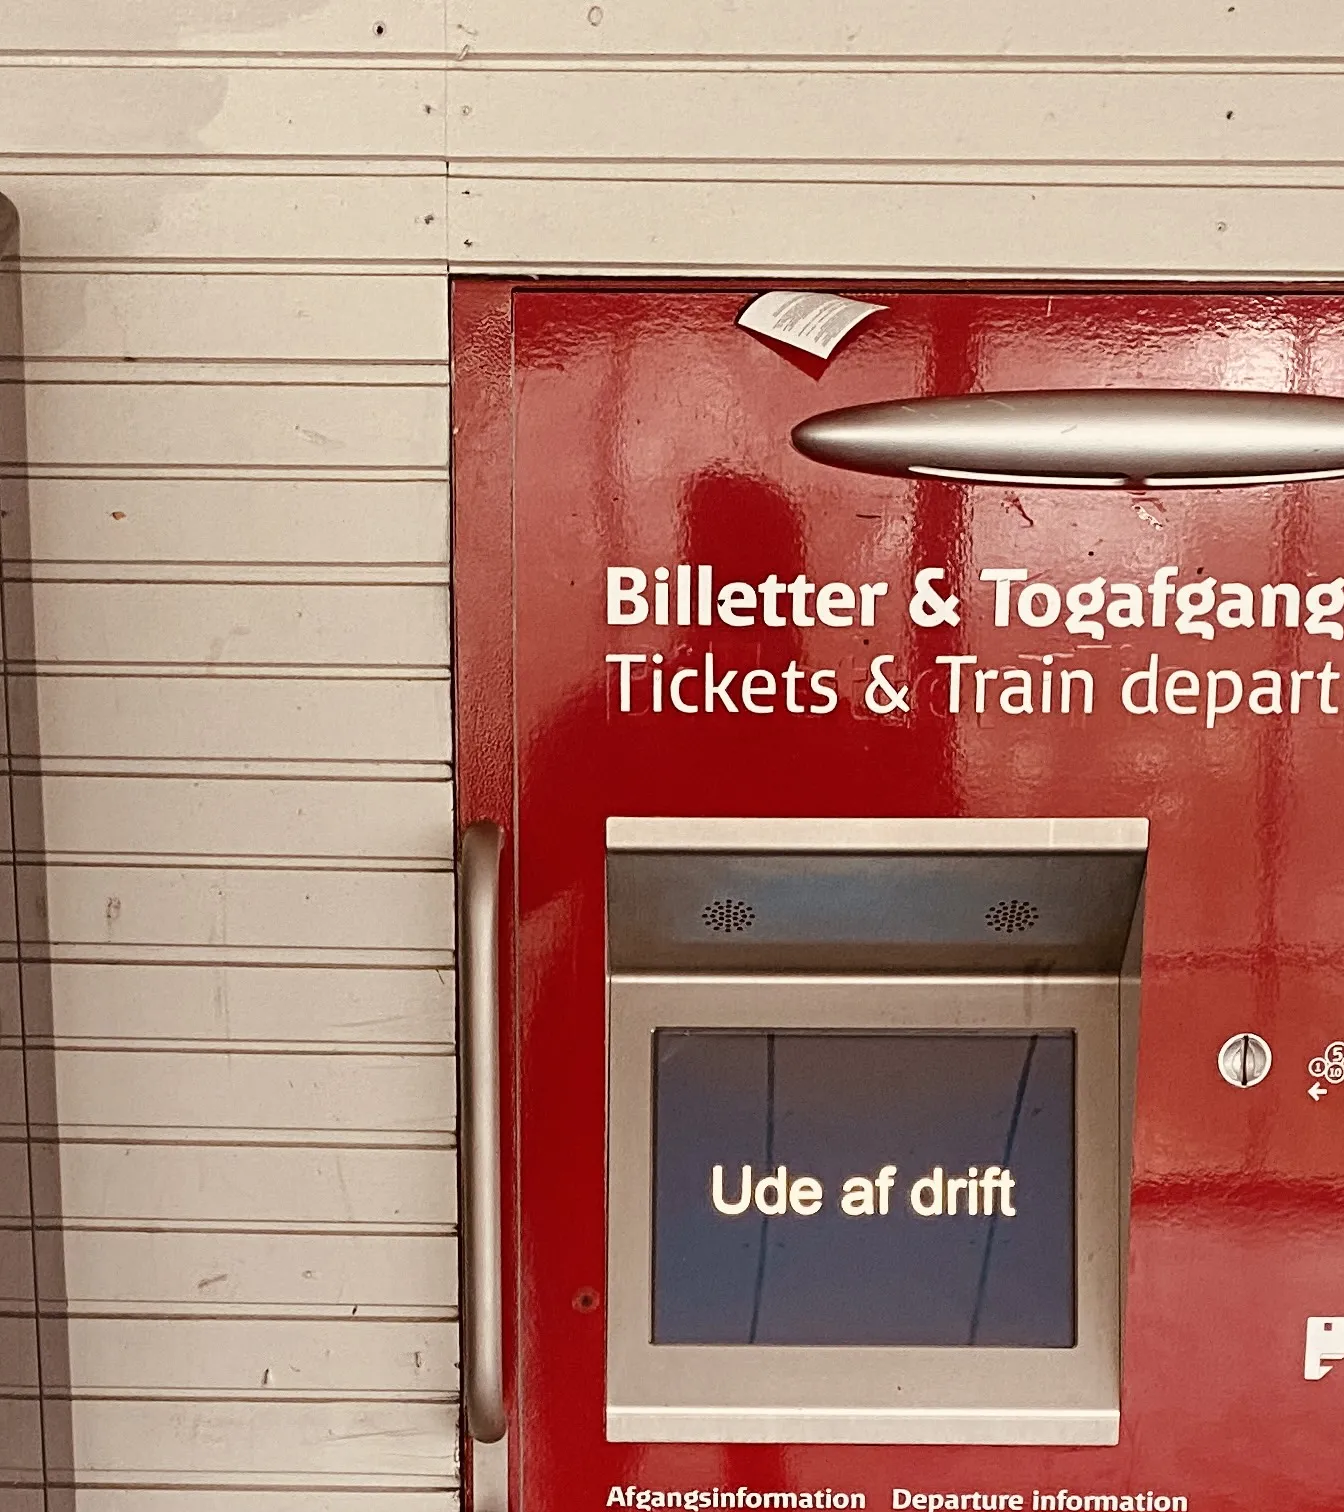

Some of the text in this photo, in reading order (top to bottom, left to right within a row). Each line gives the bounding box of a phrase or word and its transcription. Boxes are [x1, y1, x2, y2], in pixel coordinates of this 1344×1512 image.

[606, 566, 887, 627] Billetter
[909, 568, 961, 628] &
[605, 653, 838, 714] Tickets
[864, 655, 912, 714] &
[935, 655, 1095, 714] Train
[1332, 1047, 1343, 1062] 5
[1315, 1062, 1321, 1072] 1
[1329, 1068, 1342, 1077] 10
[711, 1165, 1017, 1217] Ude af drift
[606, 1486, 866, 1511] Afgangsinformation
[1032, 1490, 1188, 1512] information
